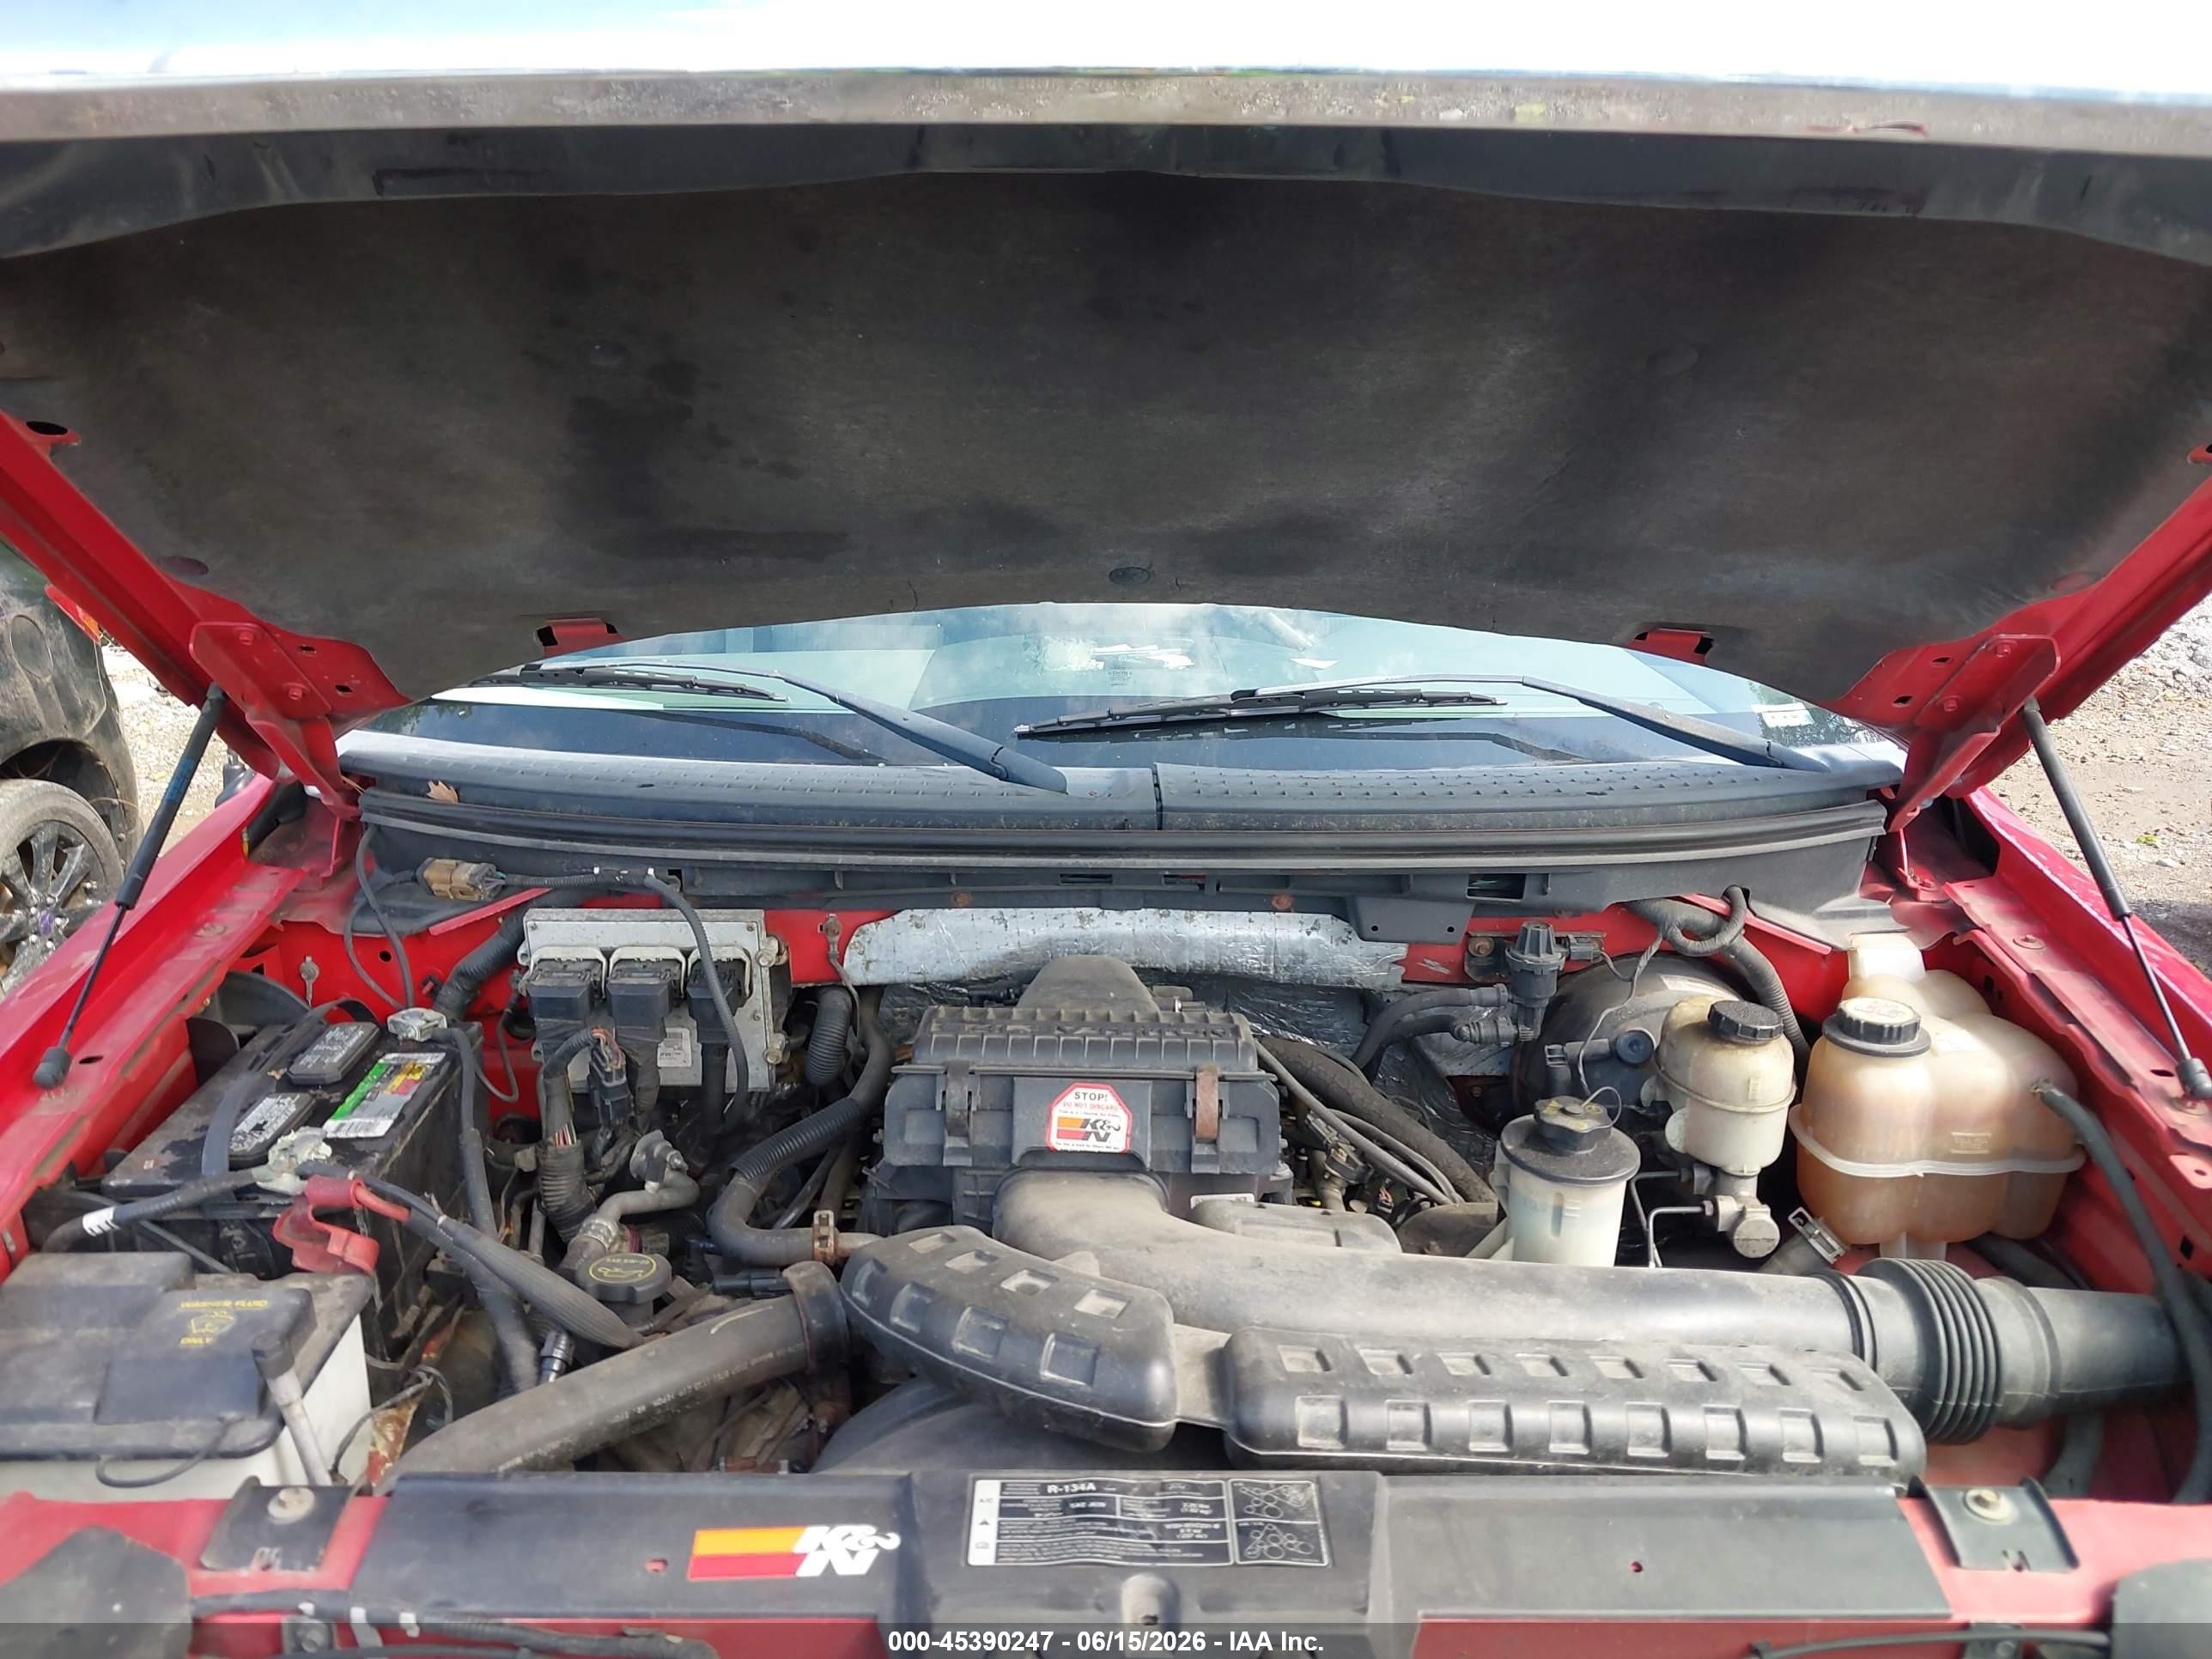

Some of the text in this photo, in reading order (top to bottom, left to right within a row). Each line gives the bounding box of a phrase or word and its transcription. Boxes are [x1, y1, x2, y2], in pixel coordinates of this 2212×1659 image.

[1074, 1091, 1108, 1102] STOP!
[1079, 1118, 1121, 1143] K&N
[1047, 1482, 1097, 1494] R-134A
[792, 1524, 901, 1577] K&N
